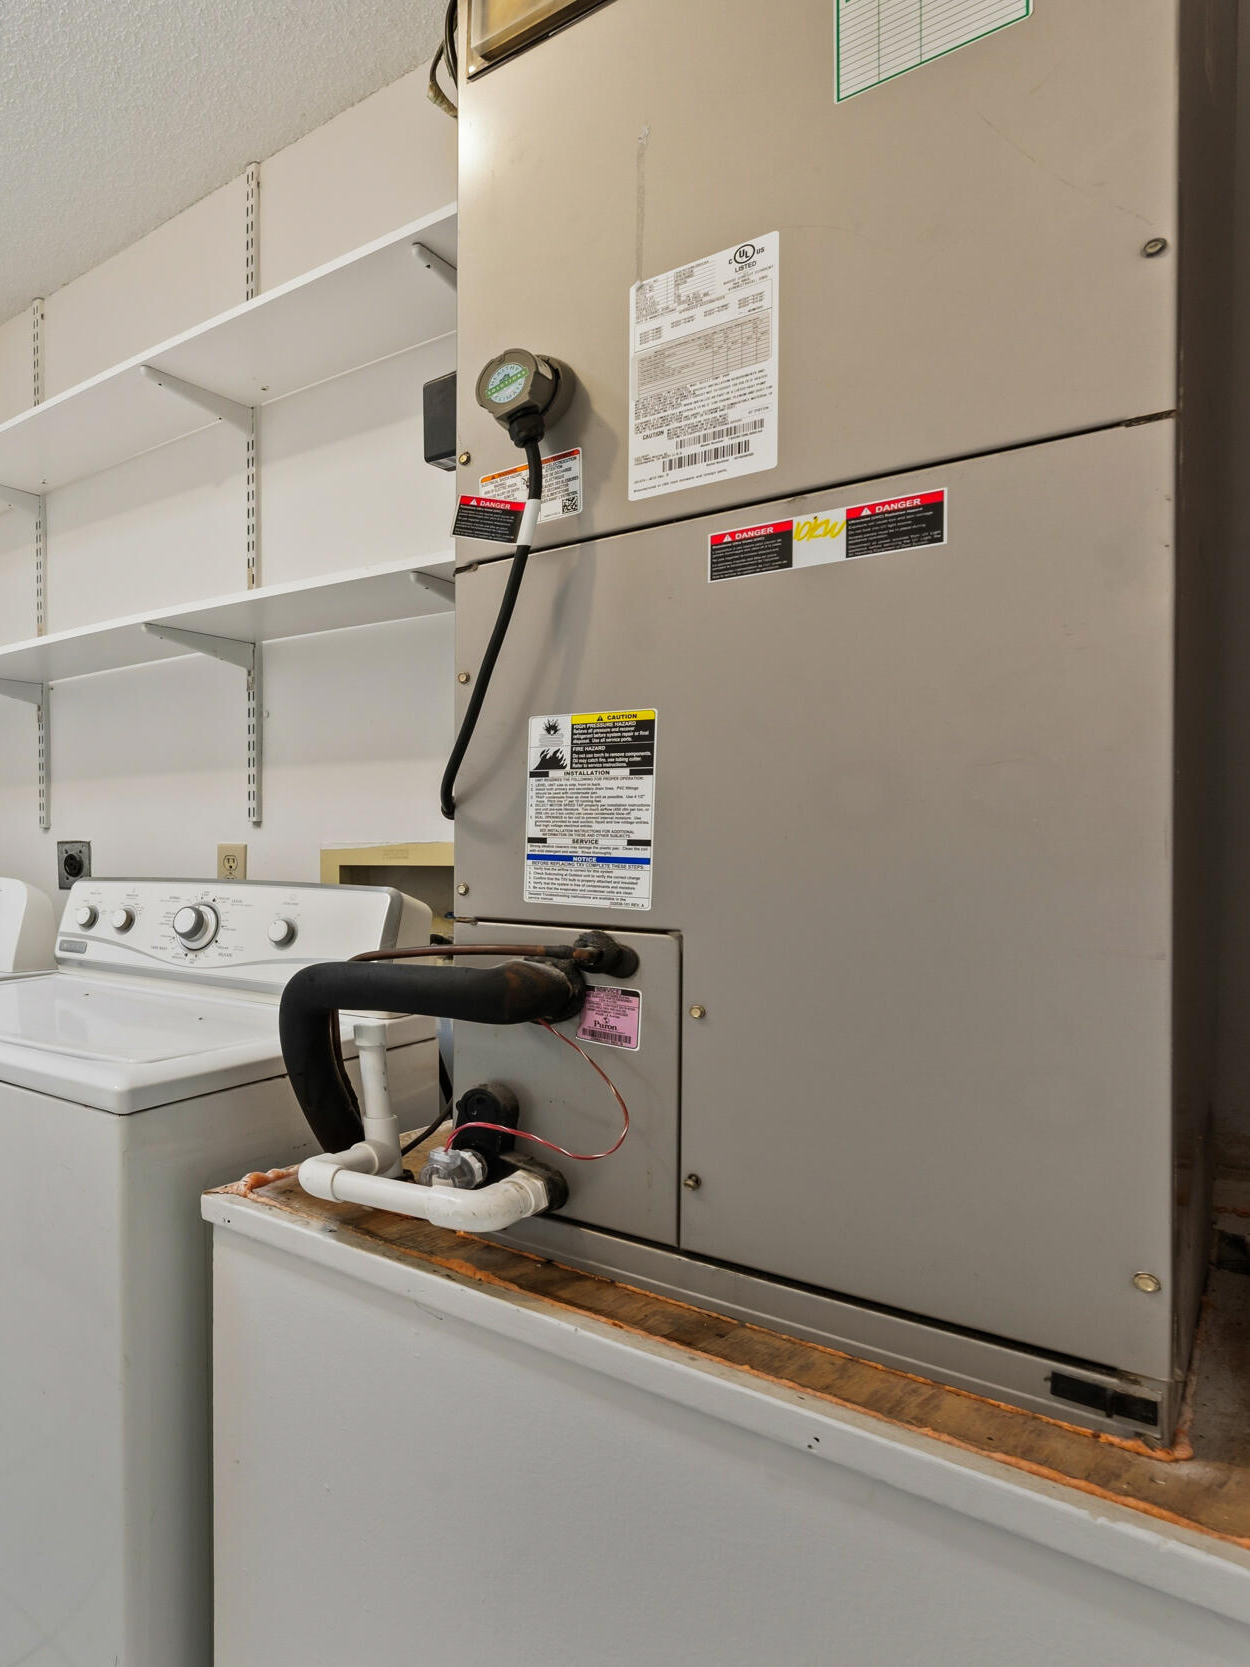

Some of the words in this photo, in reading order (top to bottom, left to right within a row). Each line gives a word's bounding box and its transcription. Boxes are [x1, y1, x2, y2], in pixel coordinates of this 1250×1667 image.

[734, 260, 756, 272] LISTED
[642, 430, 664, 440] CAUTION
[480, 501, 510, 509] DANGER
[876, 498, 921, 513] DANGER
[735, 527, 774, 540] DANGER
[594, 1020, 617, 1030] Puron
